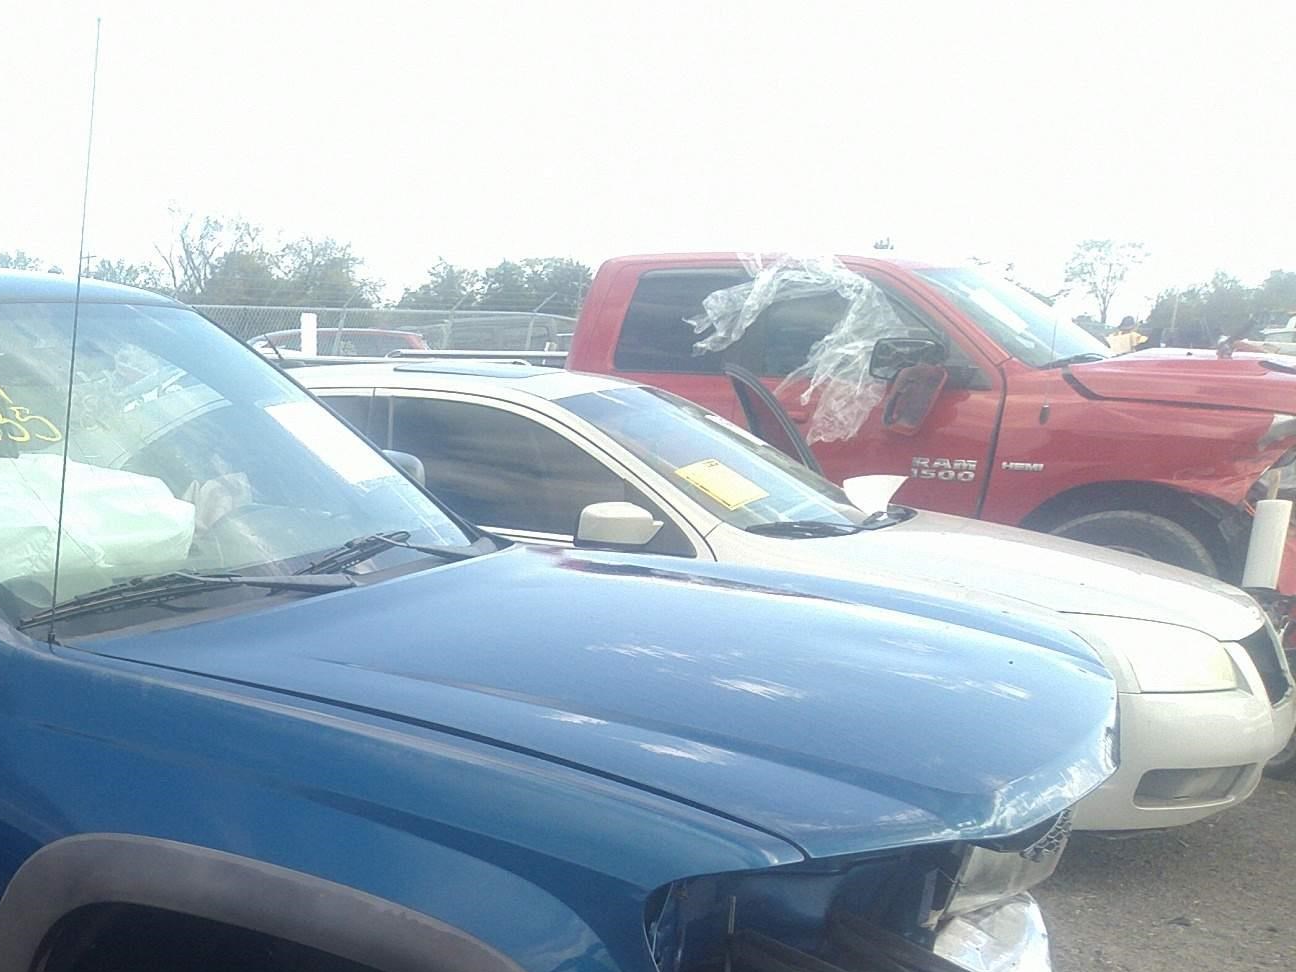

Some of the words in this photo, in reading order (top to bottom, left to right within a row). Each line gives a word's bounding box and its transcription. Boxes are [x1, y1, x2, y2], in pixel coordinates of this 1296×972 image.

[911, 456, 978, 470] RAM
[1001, 461, 1045, 472] HEMI
[910, 468, 976, 482] 1500
